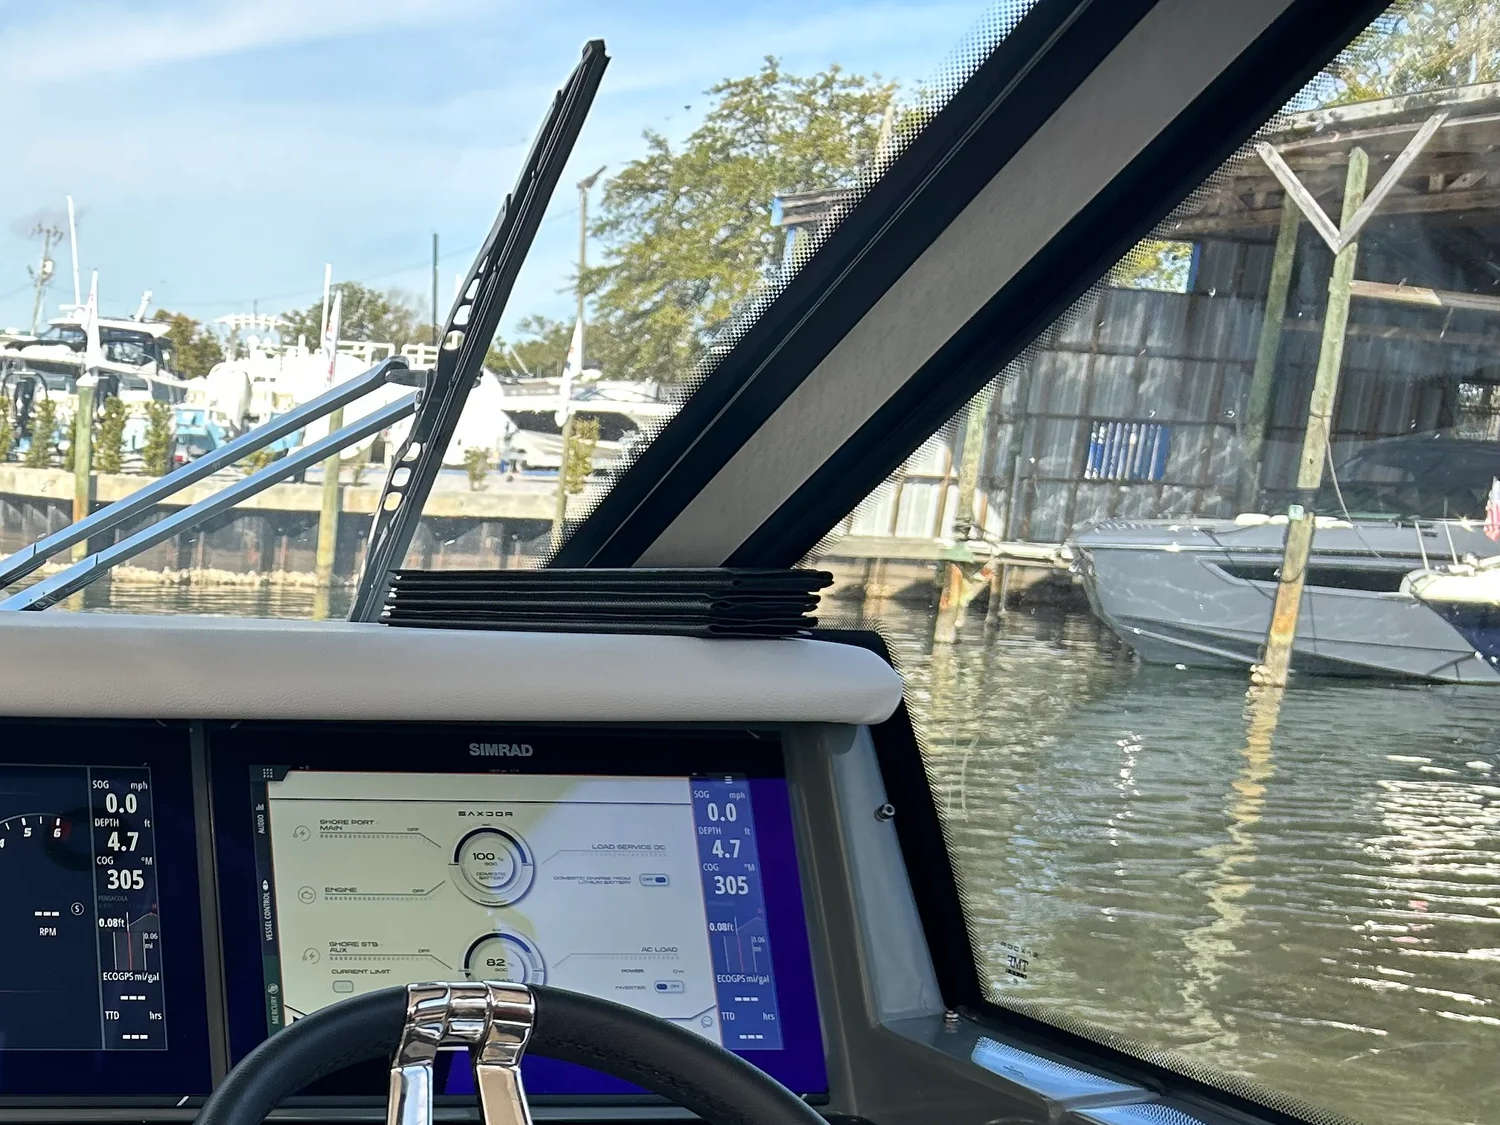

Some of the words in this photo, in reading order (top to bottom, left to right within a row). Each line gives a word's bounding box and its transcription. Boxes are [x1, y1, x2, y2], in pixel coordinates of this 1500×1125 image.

[469, 742, 534, 757] SIMRAD
[92, 779, 109, 789] SOG
[130, 780, 148, 791] mph
[693, 790, 710, 799] SOG
[729, 791, 746, 801] mph
[104, 793, 138, 814] 0.0
[707, 802, 737, 822] 0.0
[94, 818, 120, 828] DEPTH
[698, 826, 722, 836] DEPTH
[107, 831, 139, 852] 4.7
[711, 839, 741, 858] 4.7
[96, 856, 114, 866] COG
[472, 852, 495, 861] 100
[702, 862, 720, 872] COG
[107, 869, 145, 890] 305
[714, 875, 749, 895] 305
[263, 892, 272, 921] CONTROL
[98, 917, 125, 929] 0.08ft
[39, 926, 57, 936] RPM
[264, 921, 273, 942] VESSEL
[486, 958, 506, 967] 82
[102, 971, 134, 981] ECOGPS
[717, 973, 746, 983] ECOGPS
[105, 1010, 120, 1020] TTD
[149, 1010, 162, 1020] hrs
[270, 995, 279, 1025] MERCURY
[721, 1011, 735, 1021] TTD
[762, 1011, 775, 1021] hrs
